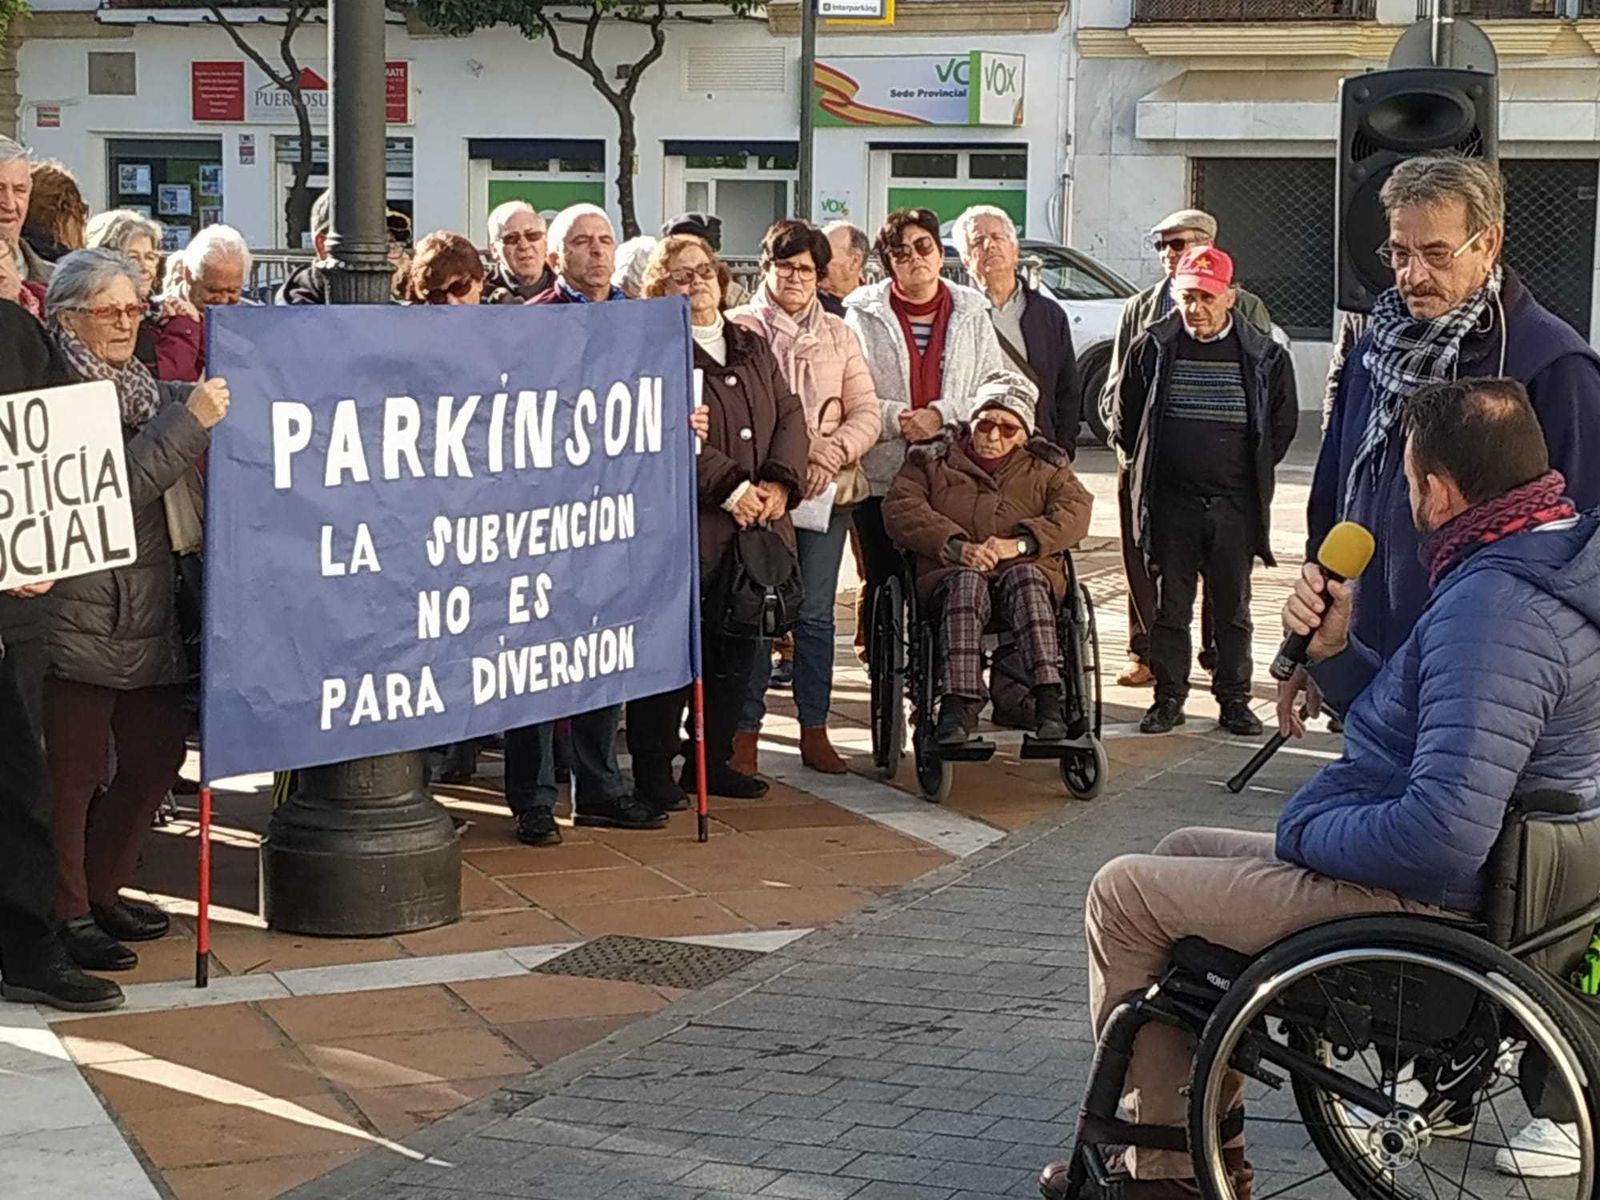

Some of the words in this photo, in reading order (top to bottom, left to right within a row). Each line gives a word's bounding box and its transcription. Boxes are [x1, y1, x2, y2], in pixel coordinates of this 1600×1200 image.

[890, 88, 915, 98] Sede
[917, 88, 967, 98] Provincial
[985, 59, 1017, 96] VOX
[255, 91, 329, 107] PUEROSU
[821, 198, 847, 213] VOX
[320, 525, 382, 577] LA
[417, 586, 471, 640] NO
[508, 572, 553, 625] ES
[320, 665, 447, 732] PARA
